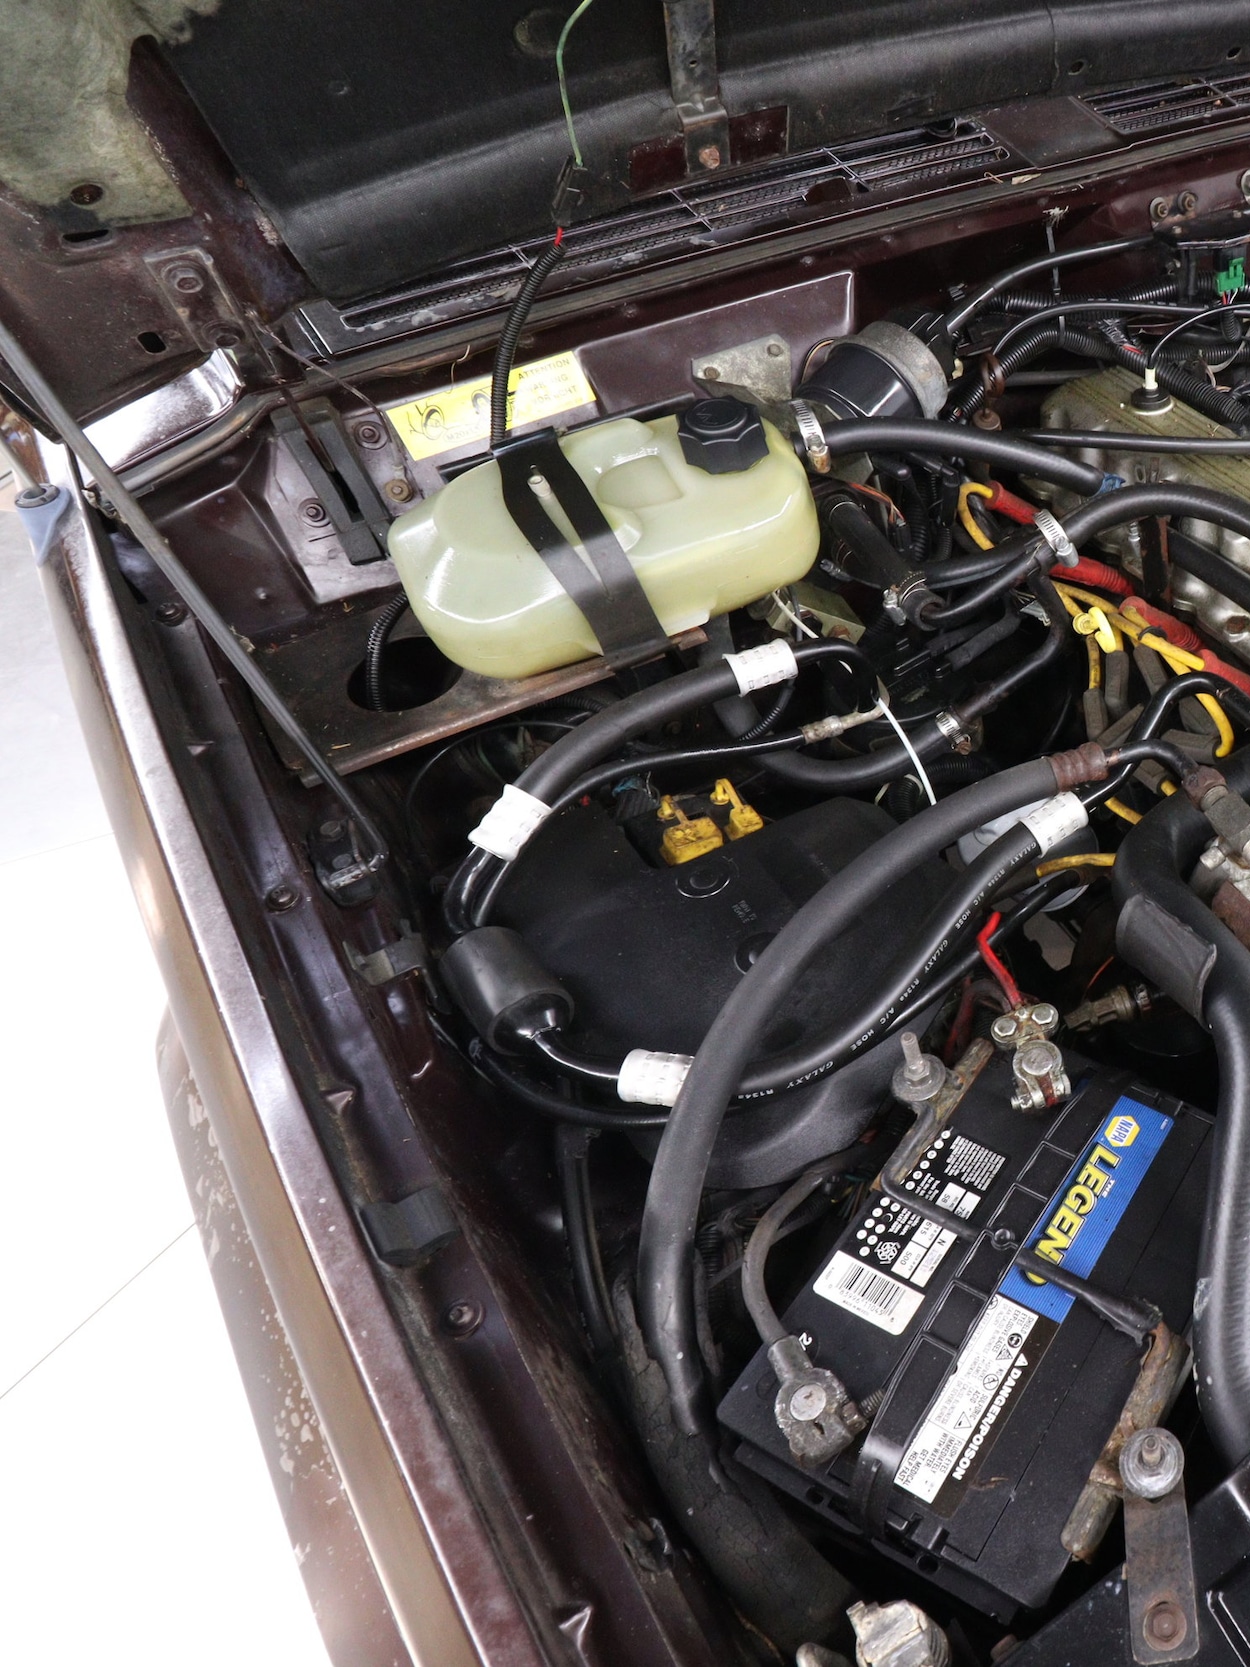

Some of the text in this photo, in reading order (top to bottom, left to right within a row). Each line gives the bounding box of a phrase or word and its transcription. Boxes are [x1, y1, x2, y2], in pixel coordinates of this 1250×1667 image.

[517, 357, 570, 380] ATTENTION
[736, 841, 1037, 1100] GALAXY R134a A/C HOSE GALAXY R134a A/C HOSE GALAXY R134a
[1109, 1117, 1134, 1145] NAPA
[1100, 1178, 1115, 1197] THE
[940, 1193, 950, 1203] 58
[919, 1220, 933, 1236] 615
[936, 1237, 946, 1247] N
[899, 1249, 912, 1266] 500
[1015, 1311, 1028, 1326] EYES
[1018, 1315, 1034, 1335] SHIELD
[990, 1308, 1020, 1353] EXPLOSIVE GASES
[994, 1366, 1004, 1377] NO
[968, 1388, 981, 1404] ACID
[967, 1392, 988, 1421] SULFURIC
[950, 1366, 1022, 1481] DANGER/POISON
[934, 1431, 949, 1448] WITH
[905, 1449, 919, 1466] HELP
[917, 1447, 929, 1461] GET
[928, 1435, 955, 1474] IMMEDIATELY
[938, 1438, 962, 1474] FLUSH EYES
[901, 1459, 922, 1487] MEDICAL
